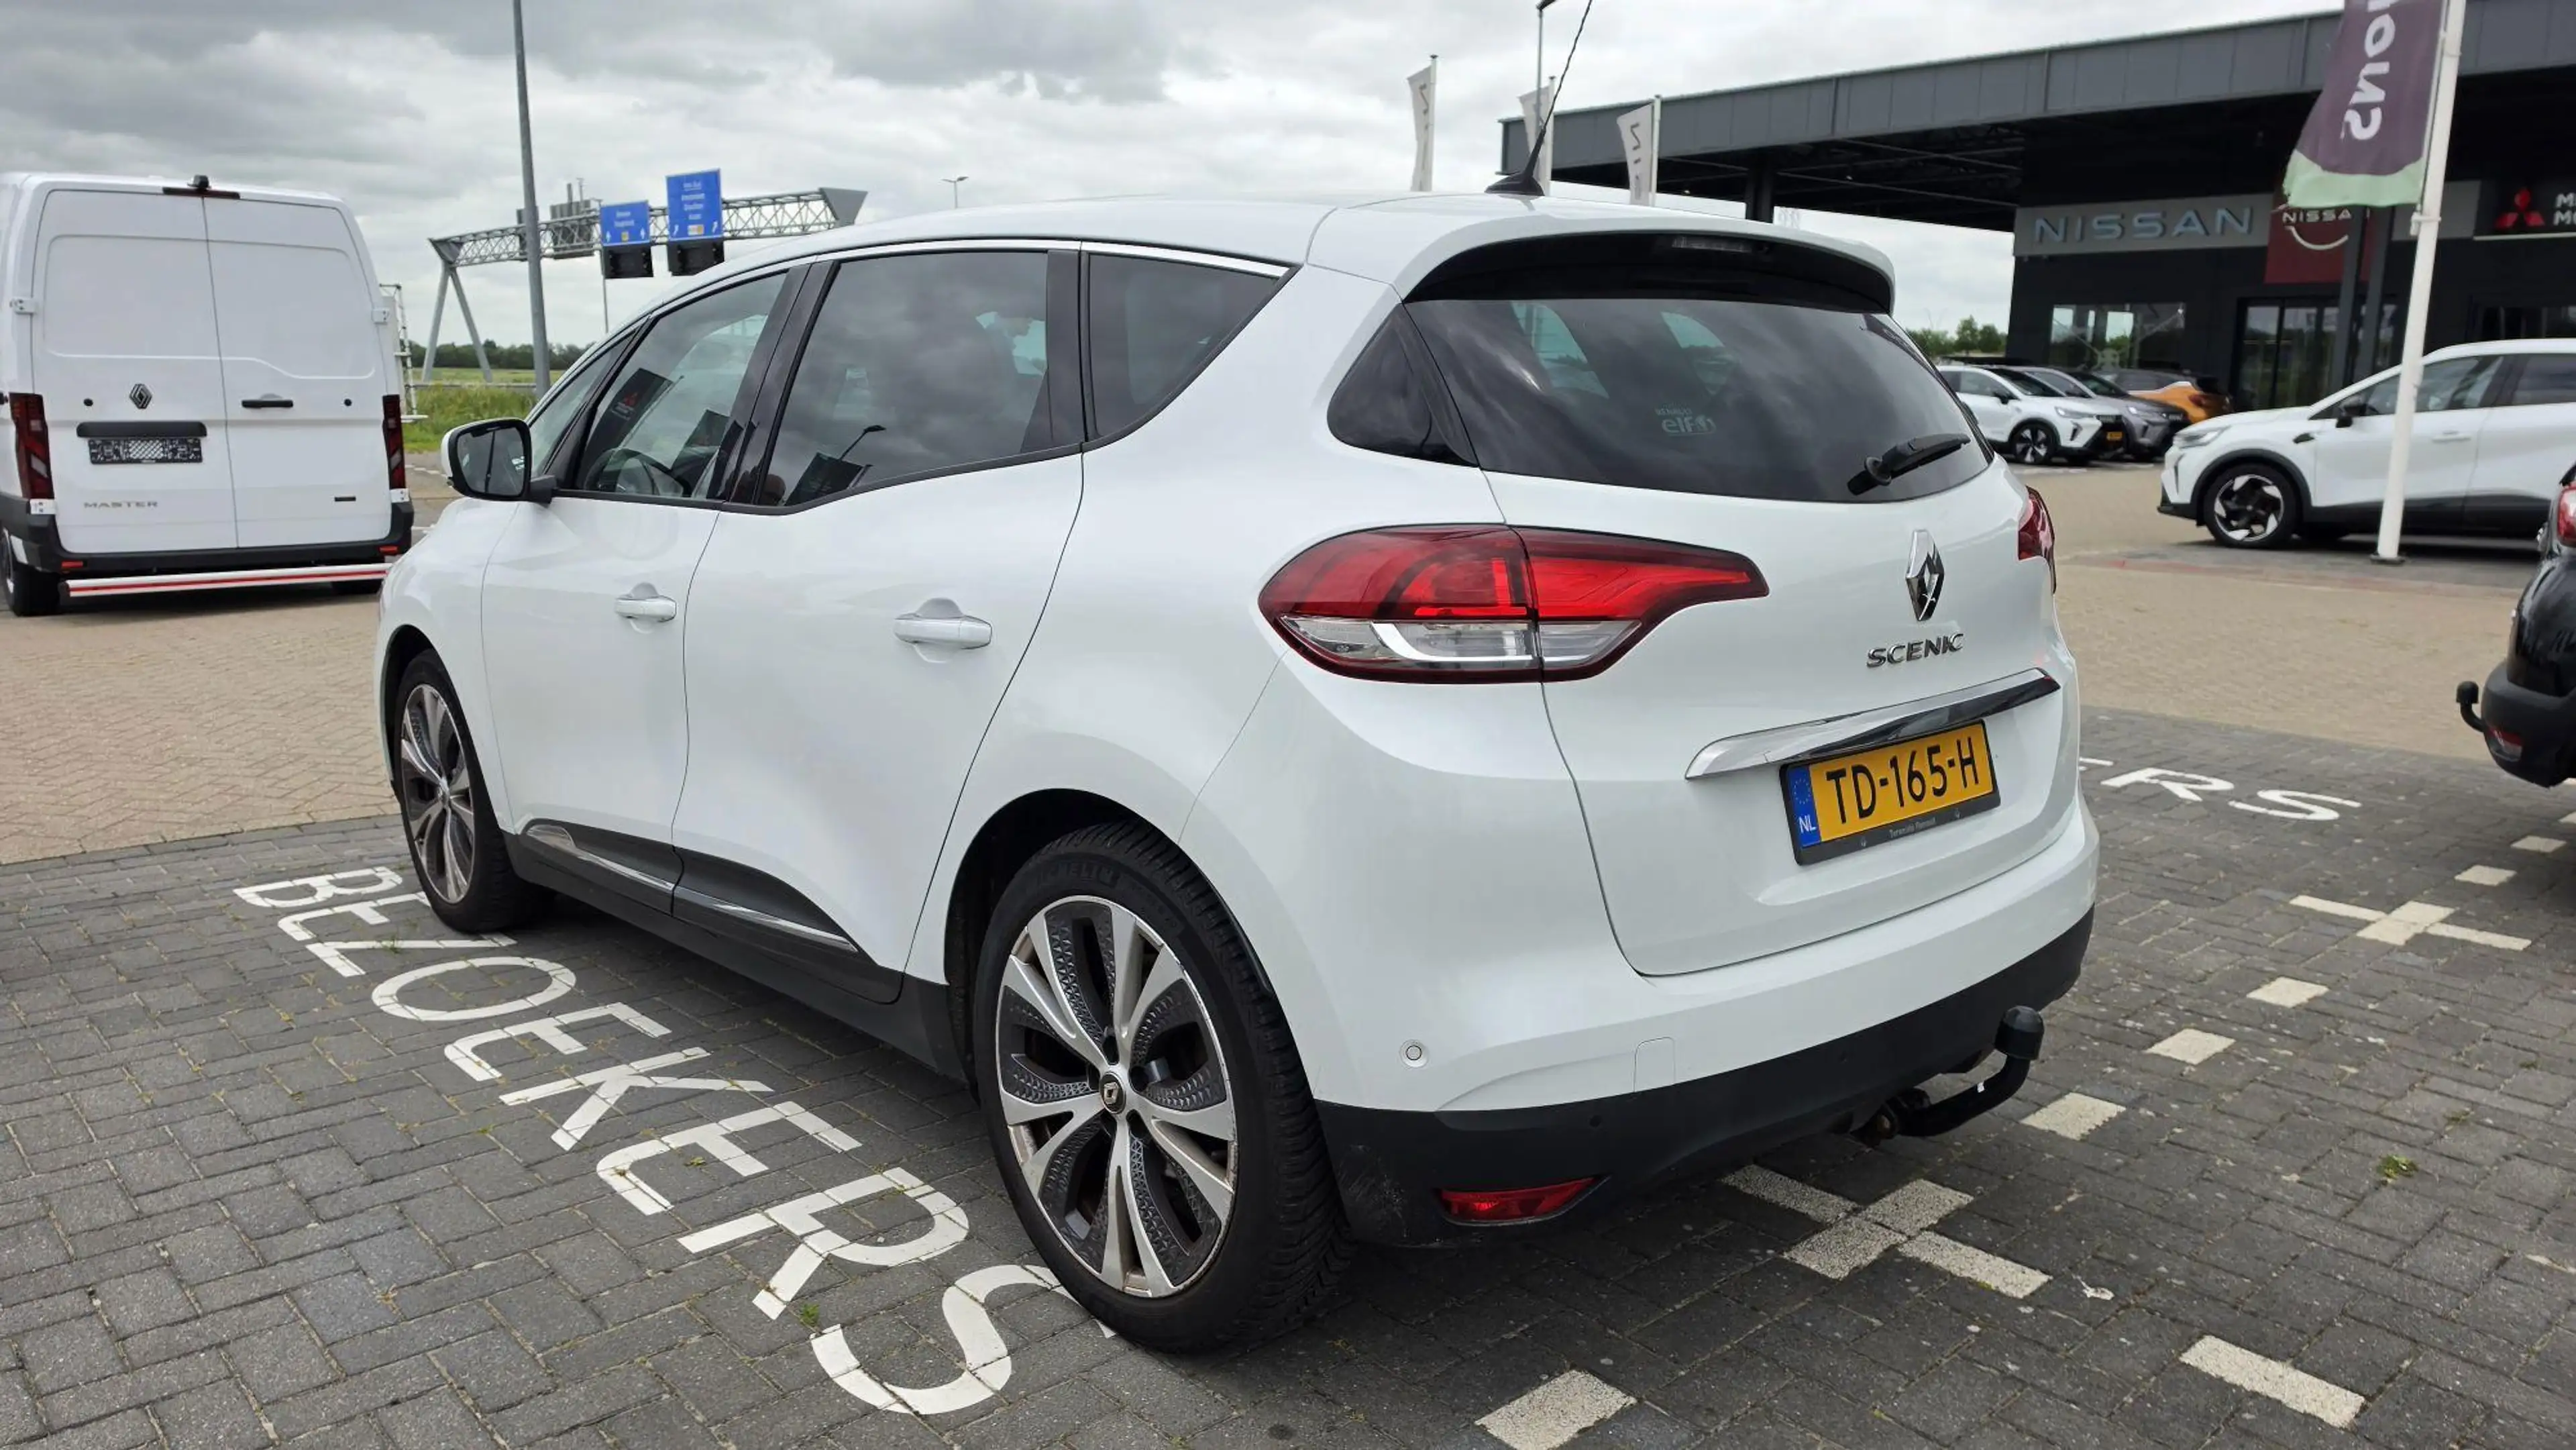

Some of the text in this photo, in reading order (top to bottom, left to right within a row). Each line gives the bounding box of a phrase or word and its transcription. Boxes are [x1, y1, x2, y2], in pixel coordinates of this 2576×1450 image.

[2556, 193, 2576, 207] M
[2035, 206, 2253, 243] NISSAN
[1662, 415, 1695, 433] elf
[83, 501, 158, 509] MASTER
[1866, 633, 1964, 668] SCENIC
[1826, 736, 1979, 825] TD-165-H
[1799, 814, 1817, 833] NL
[233, 866, 1116, 1416] BEZOEKERS
